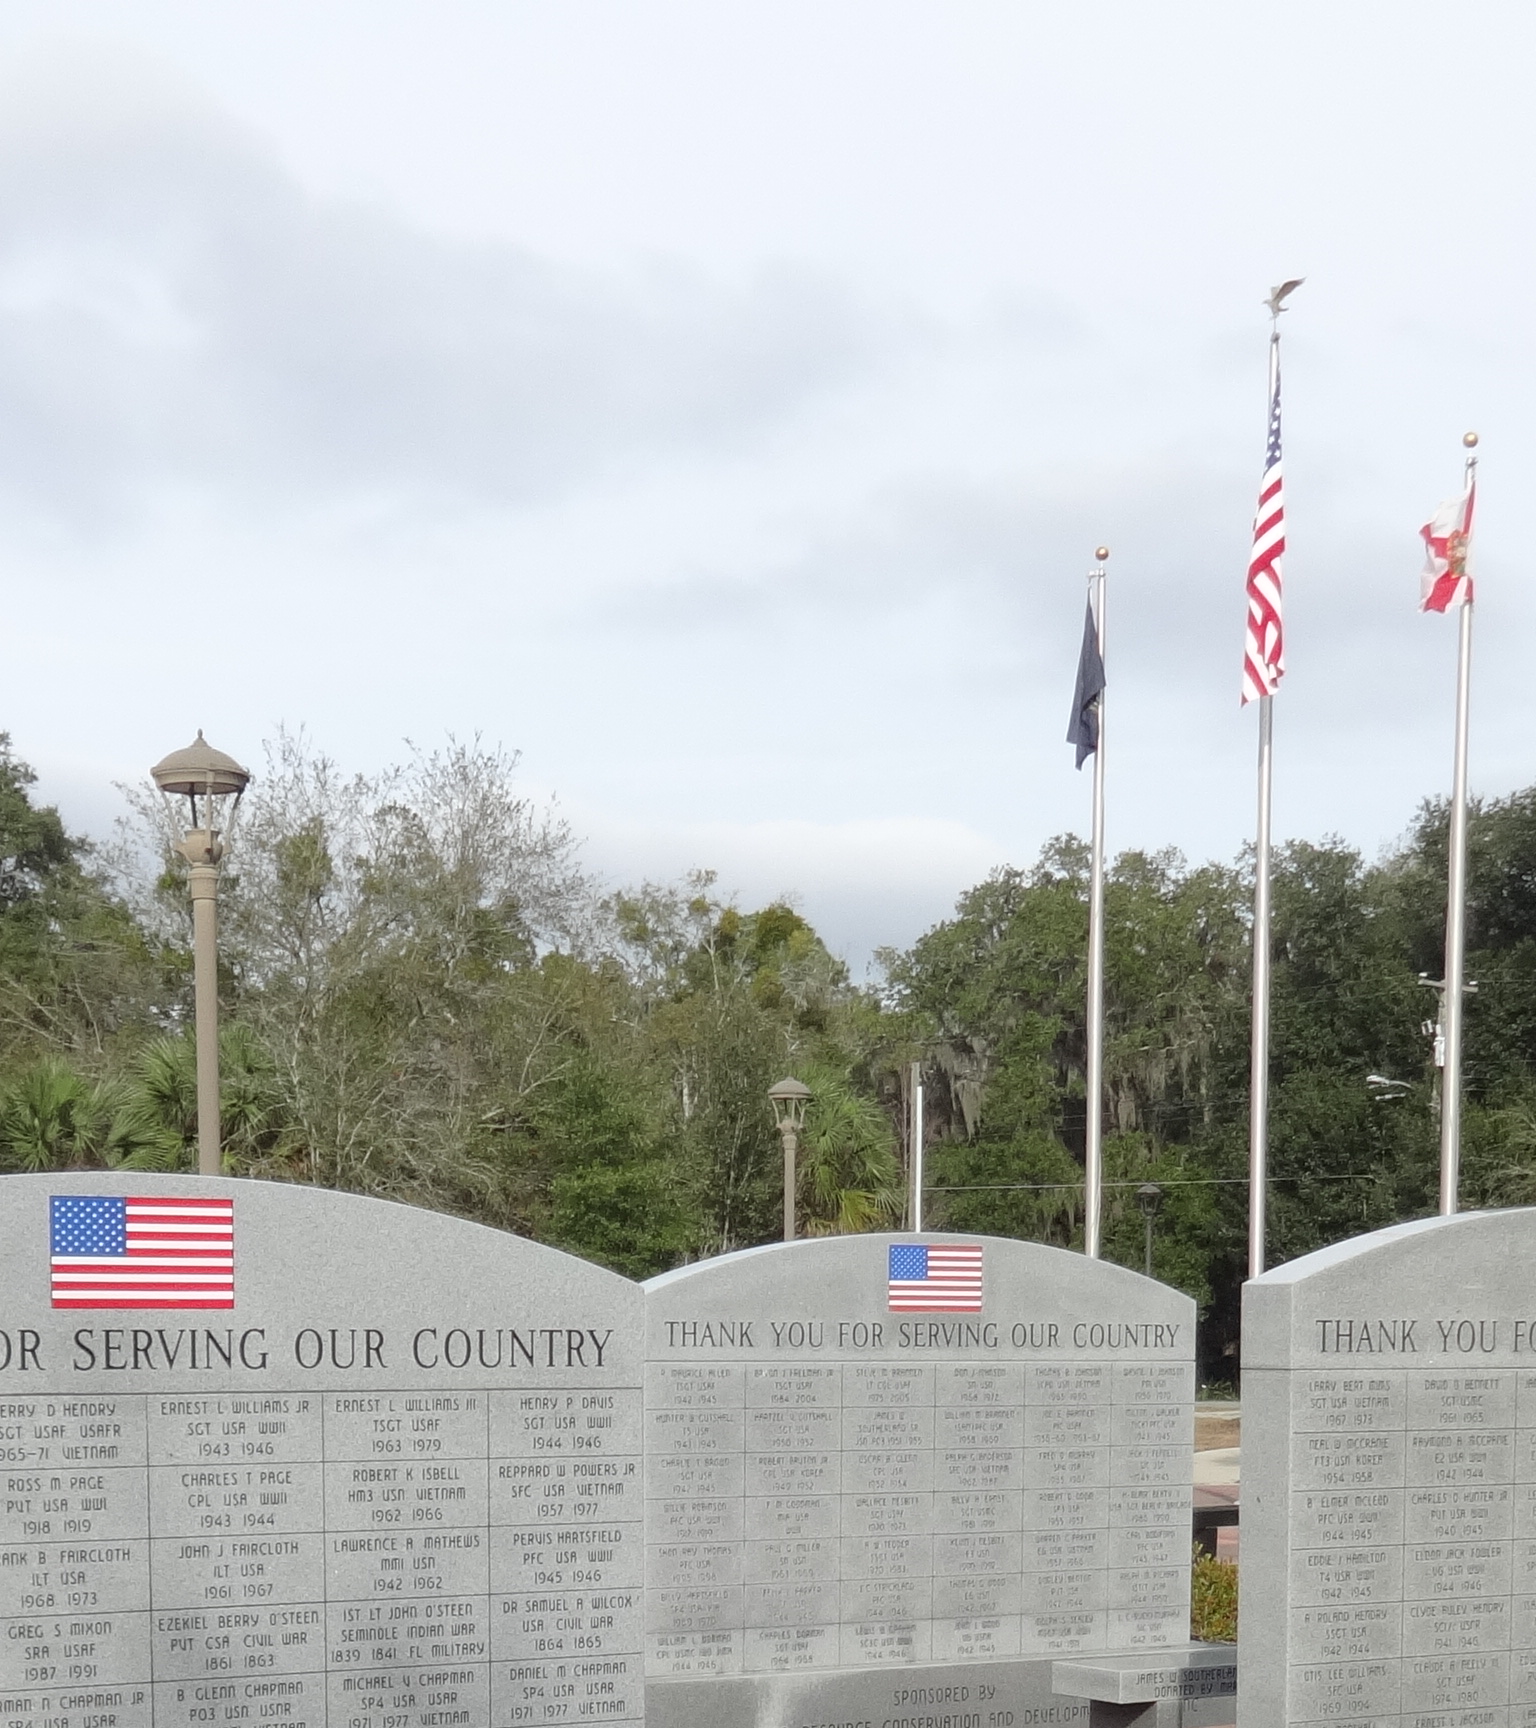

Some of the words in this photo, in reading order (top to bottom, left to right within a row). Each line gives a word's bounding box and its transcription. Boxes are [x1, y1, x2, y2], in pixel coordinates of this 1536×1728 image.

[665, 1321, 753, 1348] THANK
[770, 1321, 823, 1348] YOU
[838, 1322, 884, 1348] FOR
[899, 1322, 998, 1348] SERVING
[1012, 1323, 1059, 1348] OUR
[1073, 1323, 1180, 1349] COUNTRY
[1316, 1320, 1418, 1354] THANK
[1437, 1320, 1496, 1353] YOU
[73, 1327, 268, 1372] SERVING
[294, 1327, 386, 1372] OUR
[412, 1327, 612, 1371] COUNTRY
[353, 1469, 398, 1483] ROBERT
[406, 1468, 414, 1481] K
[422, 1467, 460, 1481] ISBELL
[348, 1489, 373, 1503] HM3
[382, 1489, 405, 1501] USN
[416, 1487, 466, 1500] VIETNAM
[372, 1509, 402, 1523] 1962
[412, 1508, 443, 1521] 1966
[1136, 1673, 1164, 1685] JAMES
[1183, 1667, 1237, 1682] SOUTHERLAN
[893, 1687, 970, 1707] SPONSORED
[978, 1685, 997, 1701] BY
[1154, 1684, 1195, 1698] DONATED
[1200, 1683, 1213, 1695] BY
[1024, 1705, 1090, 1726] DEVELOPM
